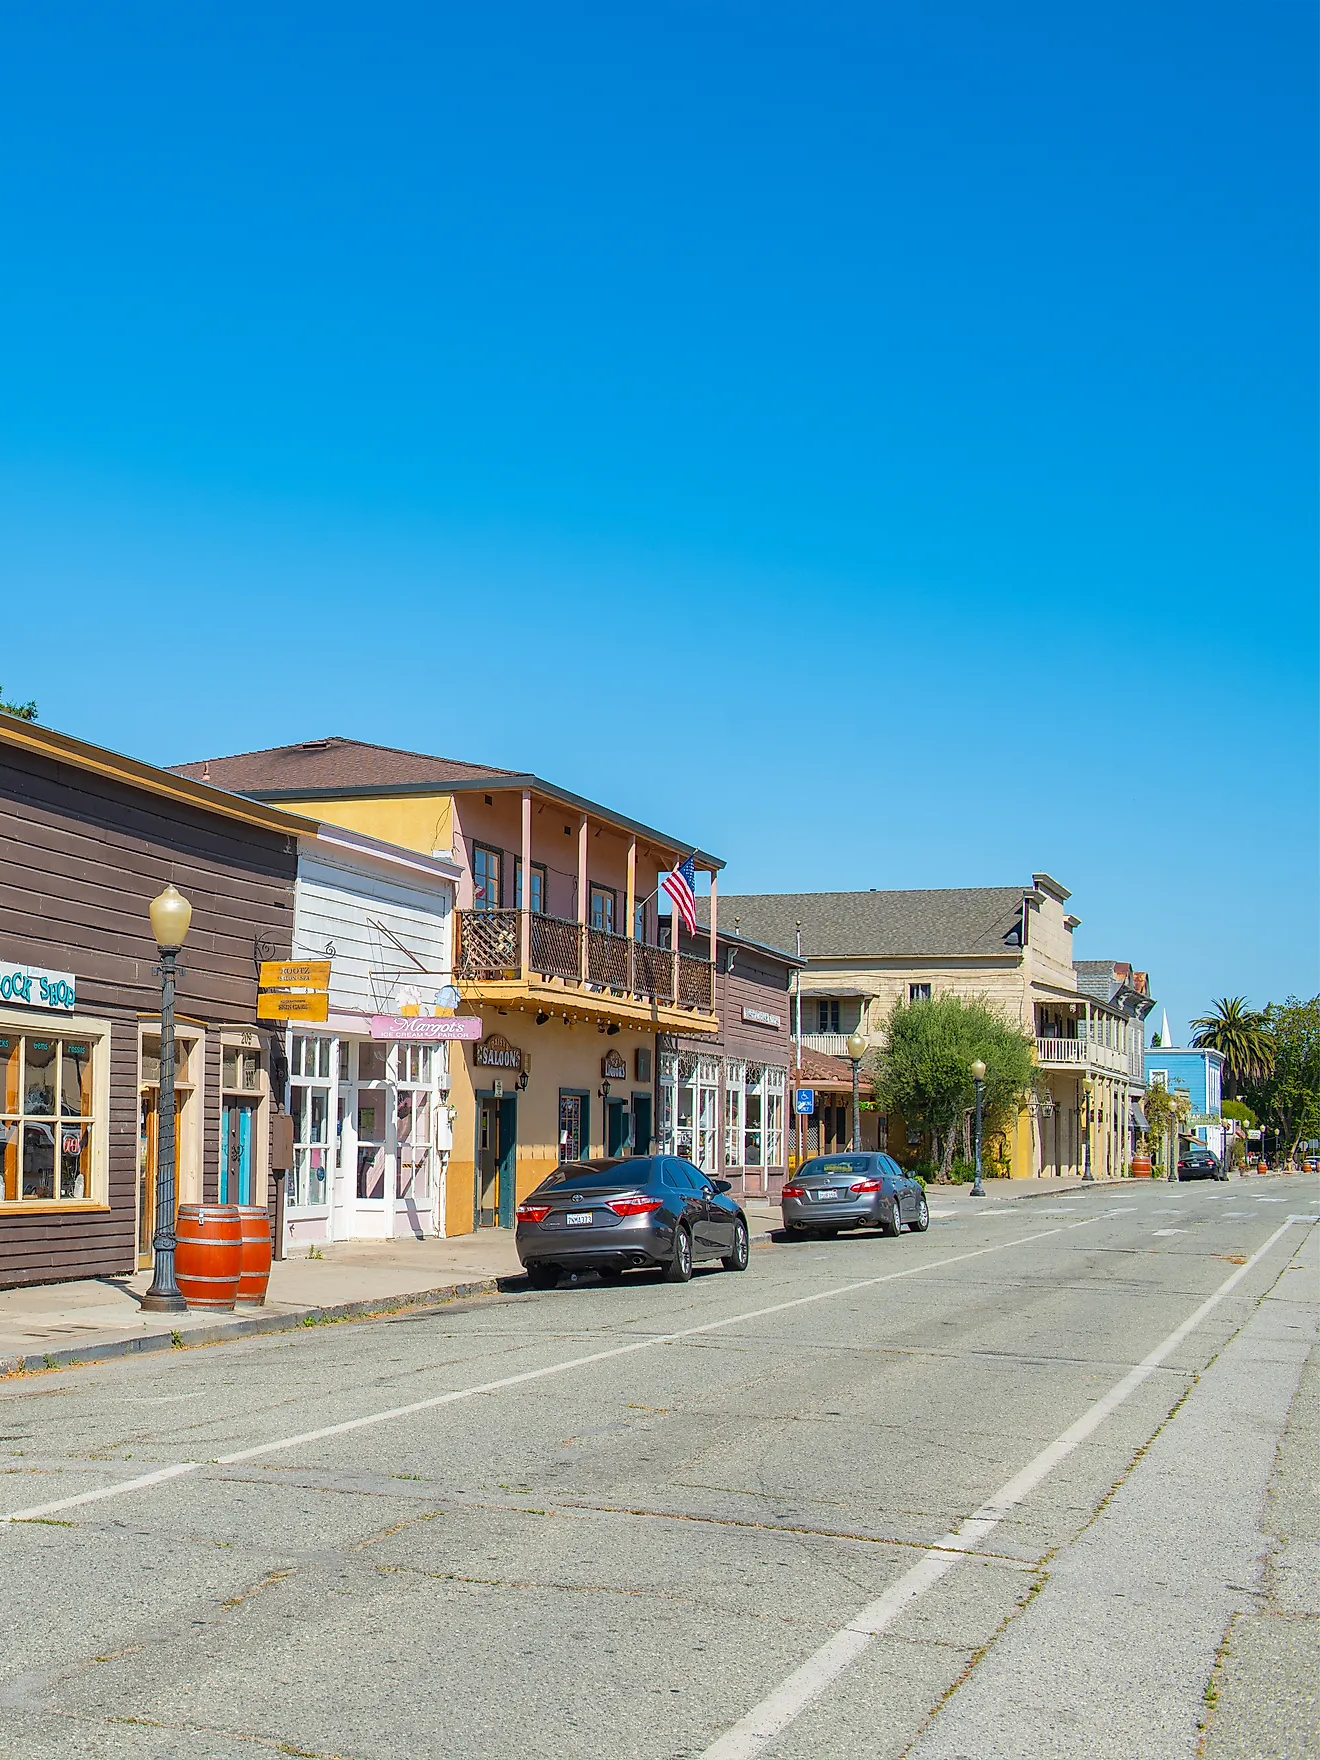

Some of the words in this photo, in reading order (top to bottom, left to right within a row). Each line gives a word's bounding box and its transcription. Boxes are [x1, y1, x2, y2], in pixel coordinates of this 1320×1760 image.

[280, 967, 310, 975] ROOTZ
[40, 976, 76, 1009] SHOP
[389, 1018, 465, 1037] Margot's
[482, 1047, 516, 1067] SALOON
